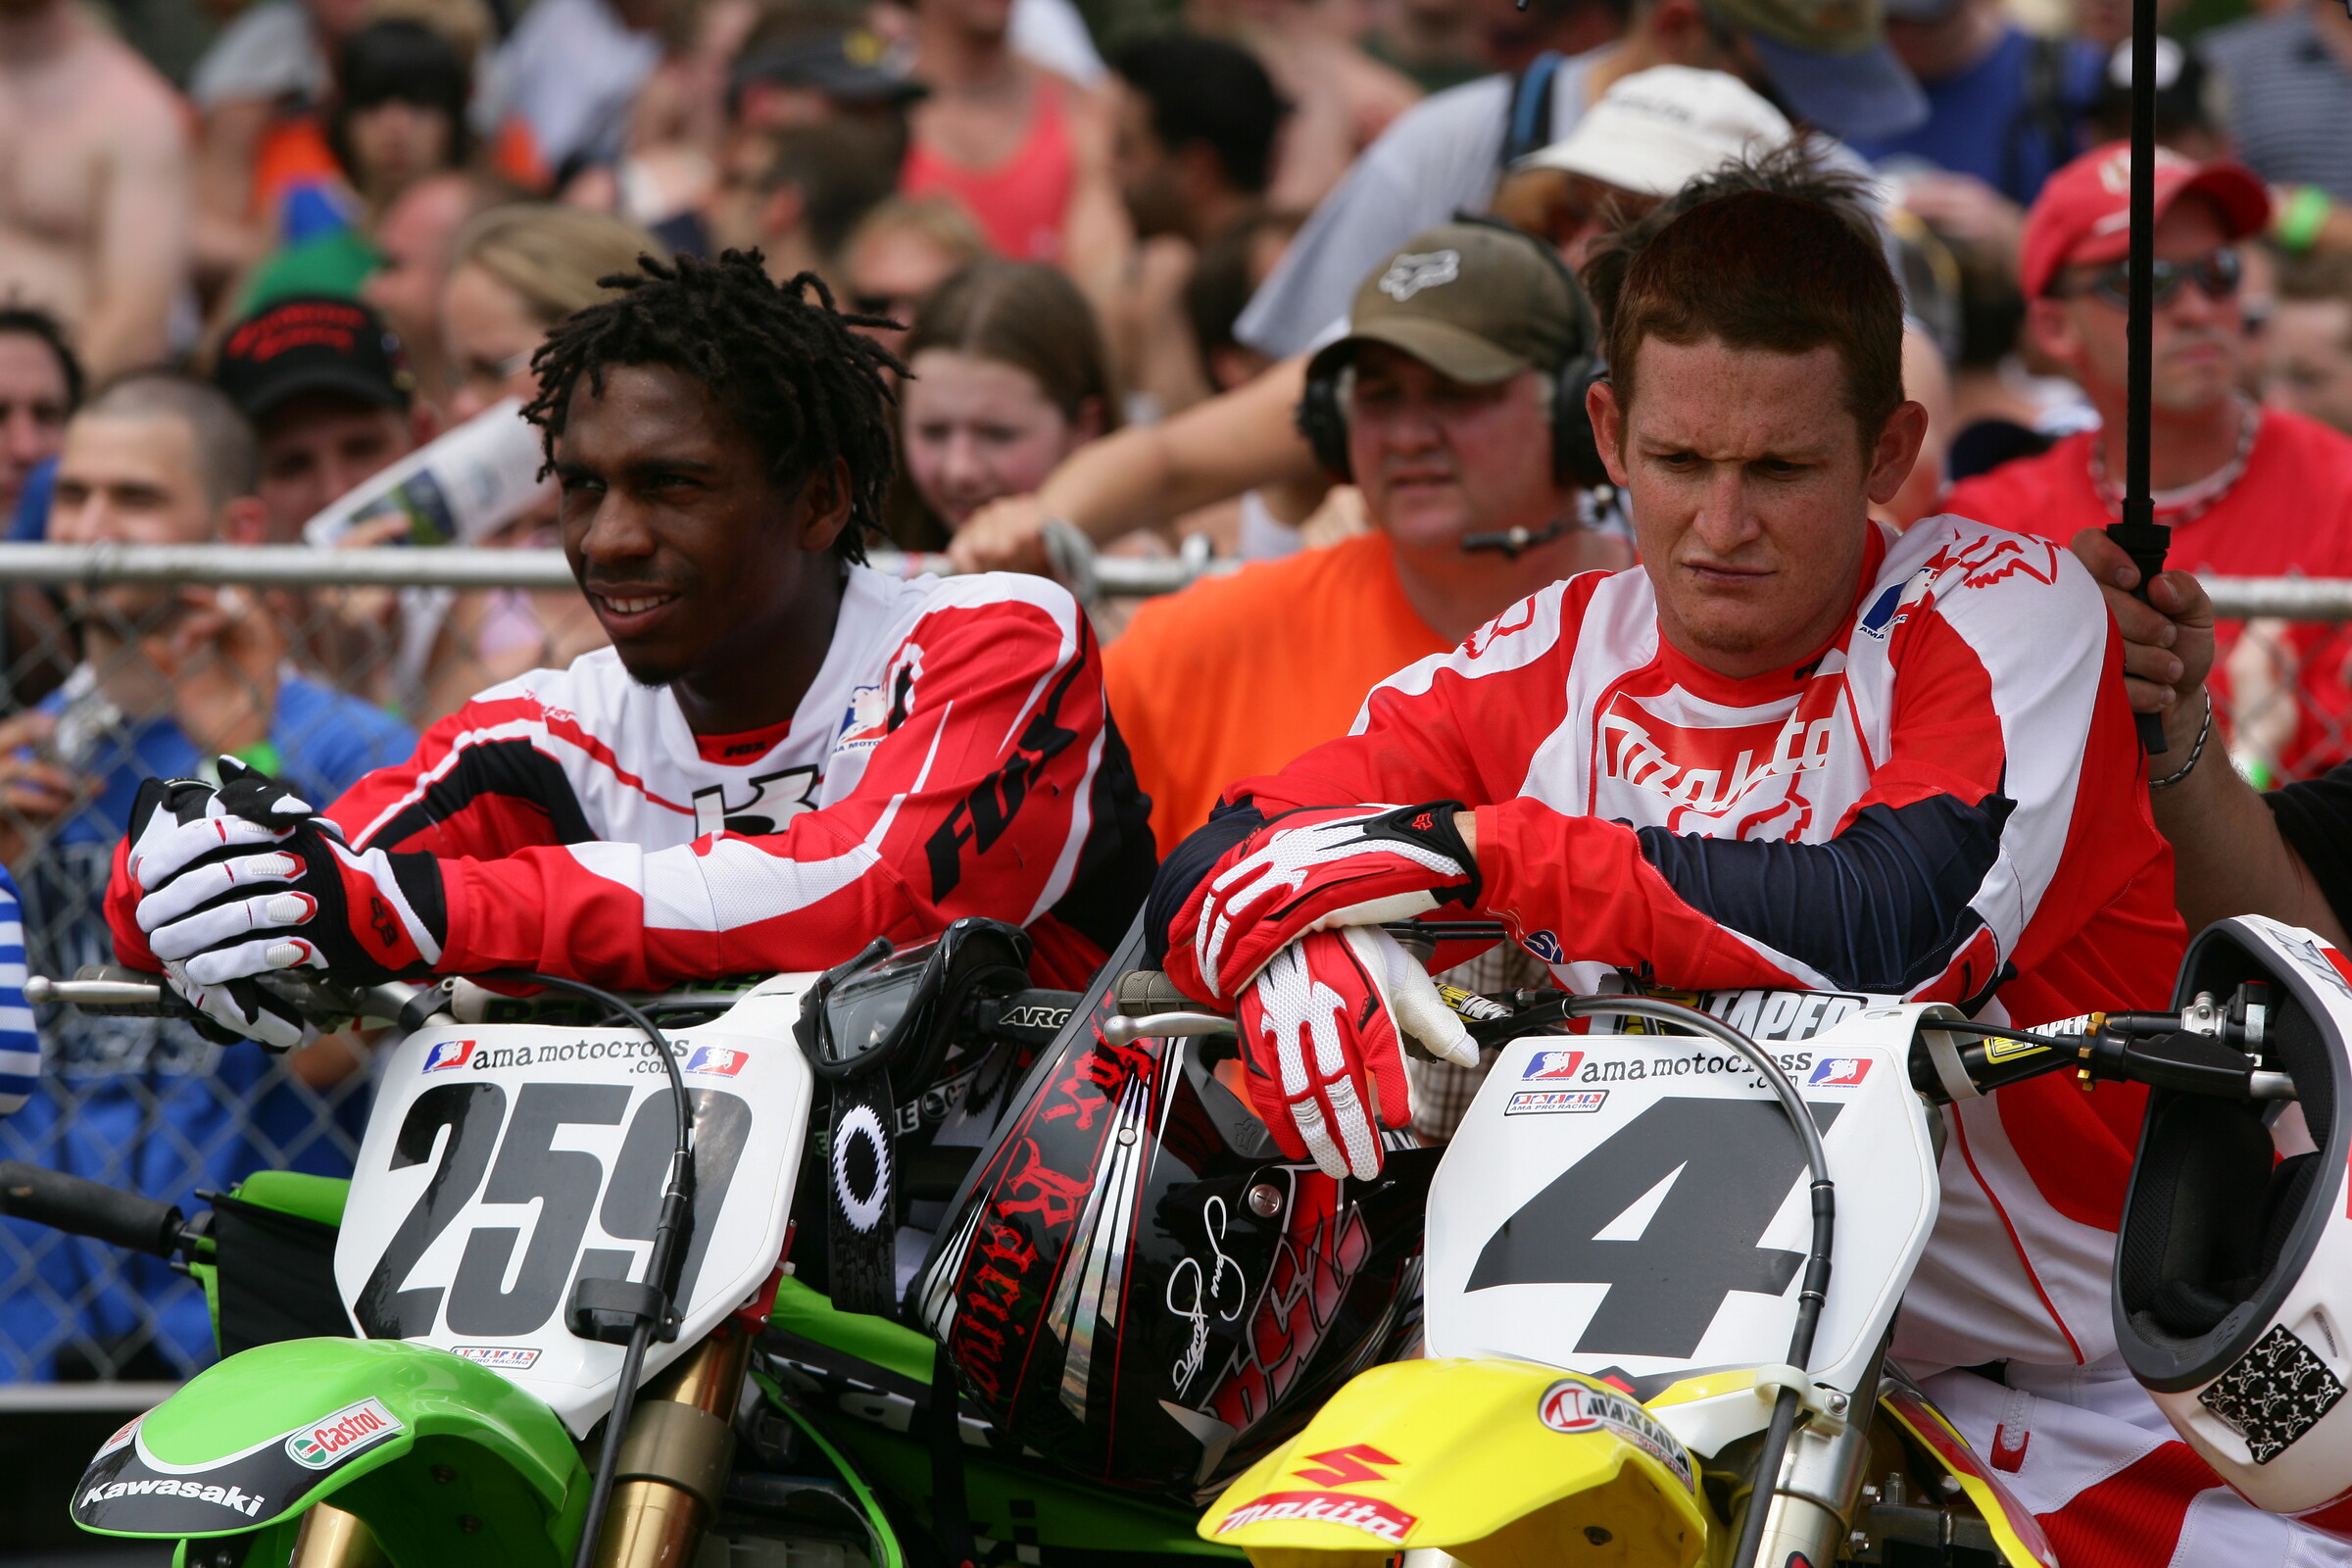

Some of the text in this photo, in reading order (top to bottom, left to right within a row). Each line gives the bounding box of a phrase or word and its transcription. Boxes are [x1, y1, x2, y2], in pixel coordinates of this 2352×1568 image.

[1859, 626, 1885, 640] AMA
[724, 741, 766, 758] FOX
[472, 1046, 533, 1070] ama
[1581, 1059, 1647, 1083] ama
[355, 1082, 753, 1340] 259
[1464, 1096, 1845, 1359] 4
[314, 1406, 387, 1452] Castrol
[1587, 1396, 1690, 1474] MAXIMA
[79, 1479, 266, 1518] Kawasaki
